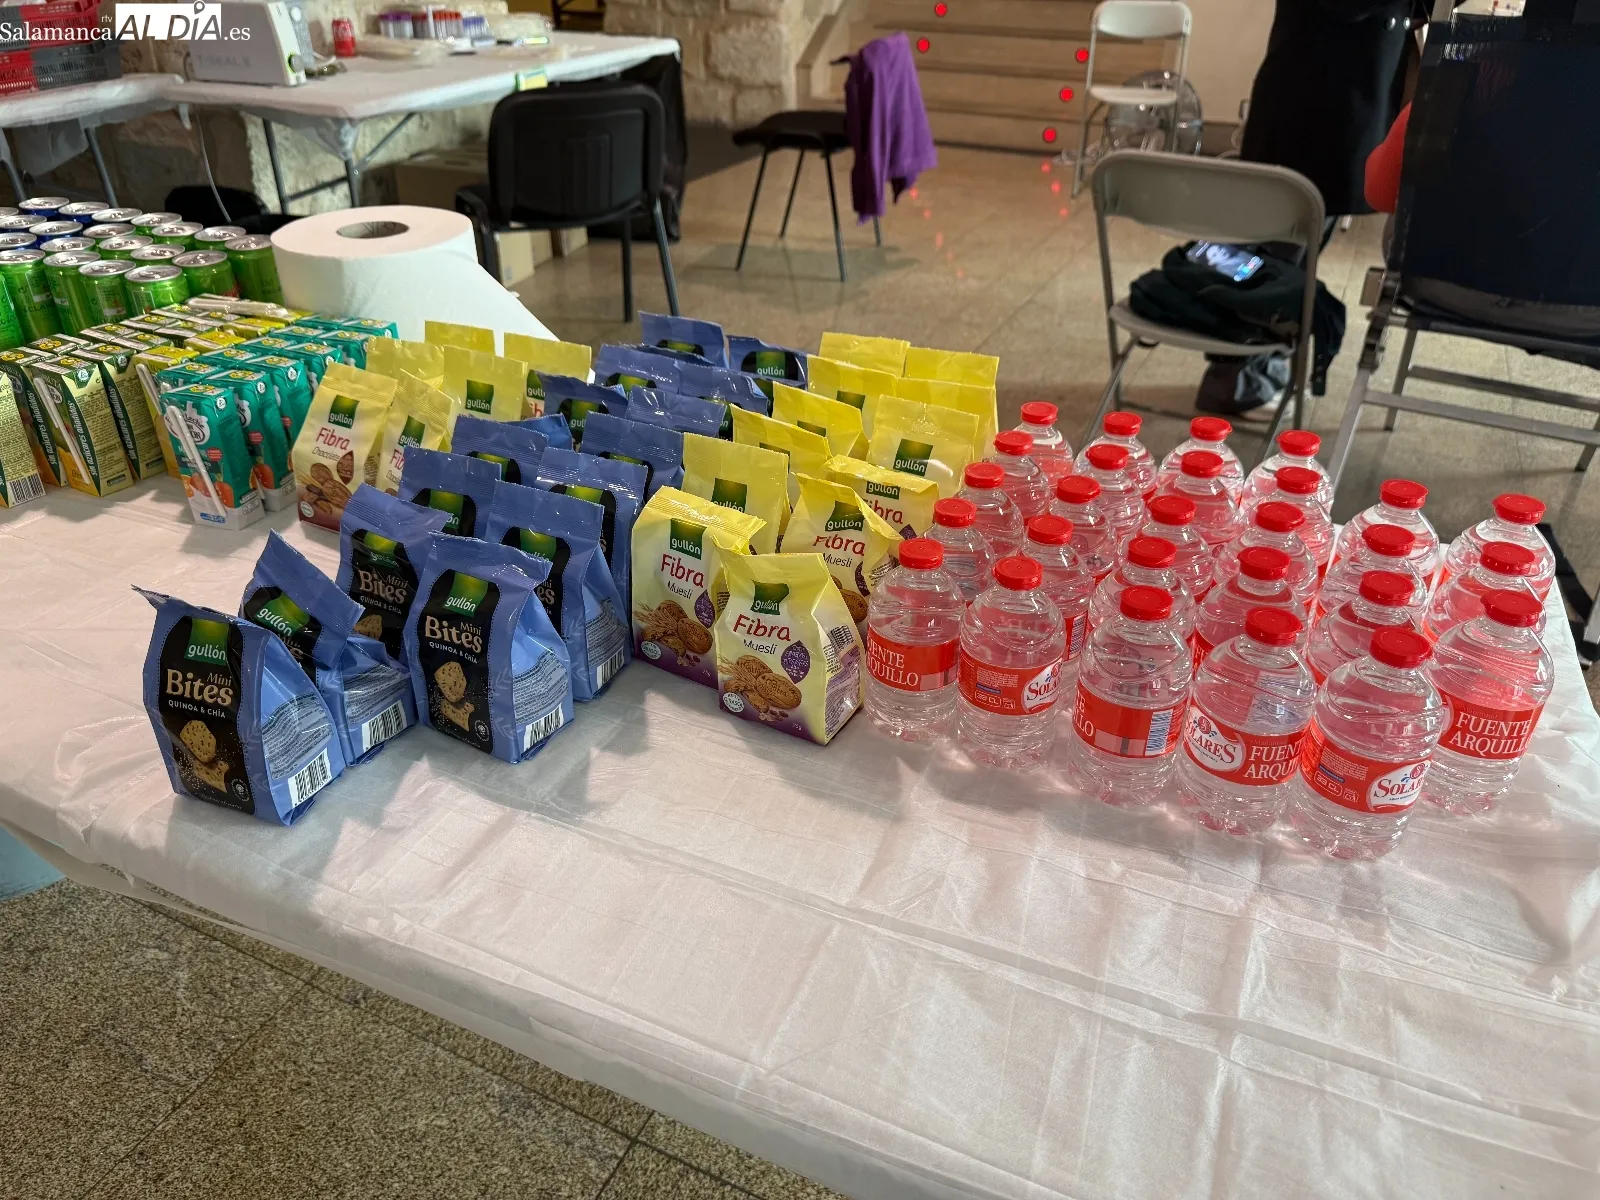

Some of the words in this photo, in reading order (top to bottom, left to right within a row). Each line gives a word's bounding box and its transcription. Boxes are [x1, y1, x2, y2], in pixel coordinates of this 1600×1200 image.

[466, 399, 491, 411] gullón
[330, 413, 353, 427] gullón
[38, 424, 55, 455] azúcares
[315, 427, 351, 451] Fibra
[79, 433, 95, 465] azúcares
[895, 458, 926, 473] gullón
[827, 520, 862, 531] gullón
[671, 538, 701, 555] gullón
[813, 534, 866, 557] Fibra
[823, 552, 853, 568] Muesli
[660, 553, 705, 588] Fibra
[358, 569, 408, 605] Bites
[385, 574, 409, 589] Mini
[445, 596, 476, 613] gullón
[256, 608, 293, 637] gullón
[460, 621, 482, 636] Mini
[732, 613, 791, 642] Fibra
[424, 615, 483, 654] Bites
[187, 644, 226, 661] gullón
[429, 641, 458, 655] QUINOA
[743, 638, 778, 655] Muesli
[166, 668, 234, 707] Bites
[206, 672, 232, 686] Mini
[168, 699, 199, 712] QUINOA
[200, 706, 206, 714] &
[207, 708, 226, 719] CHÍA
[1455, 711, 1532, 738] FUENTE
